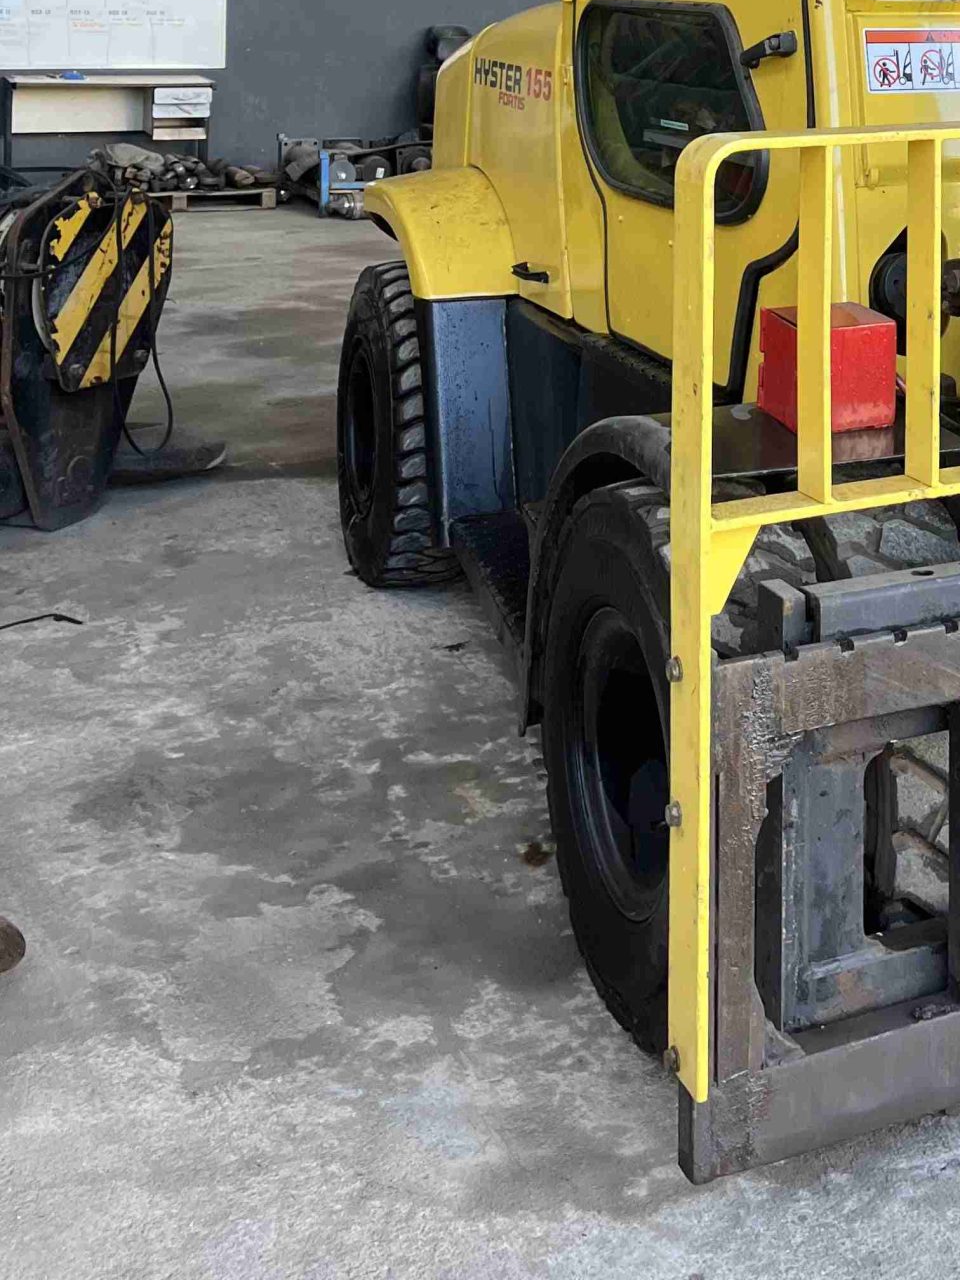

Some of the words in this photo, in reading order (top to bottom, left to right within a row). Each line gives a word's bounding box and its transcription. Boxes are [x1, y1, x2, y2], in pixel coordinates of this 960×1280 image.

[474, 58, 522, 94] HYSTER
[525, 66, 553, 101] 155
[498, 92, 526, 111] FORTIS
